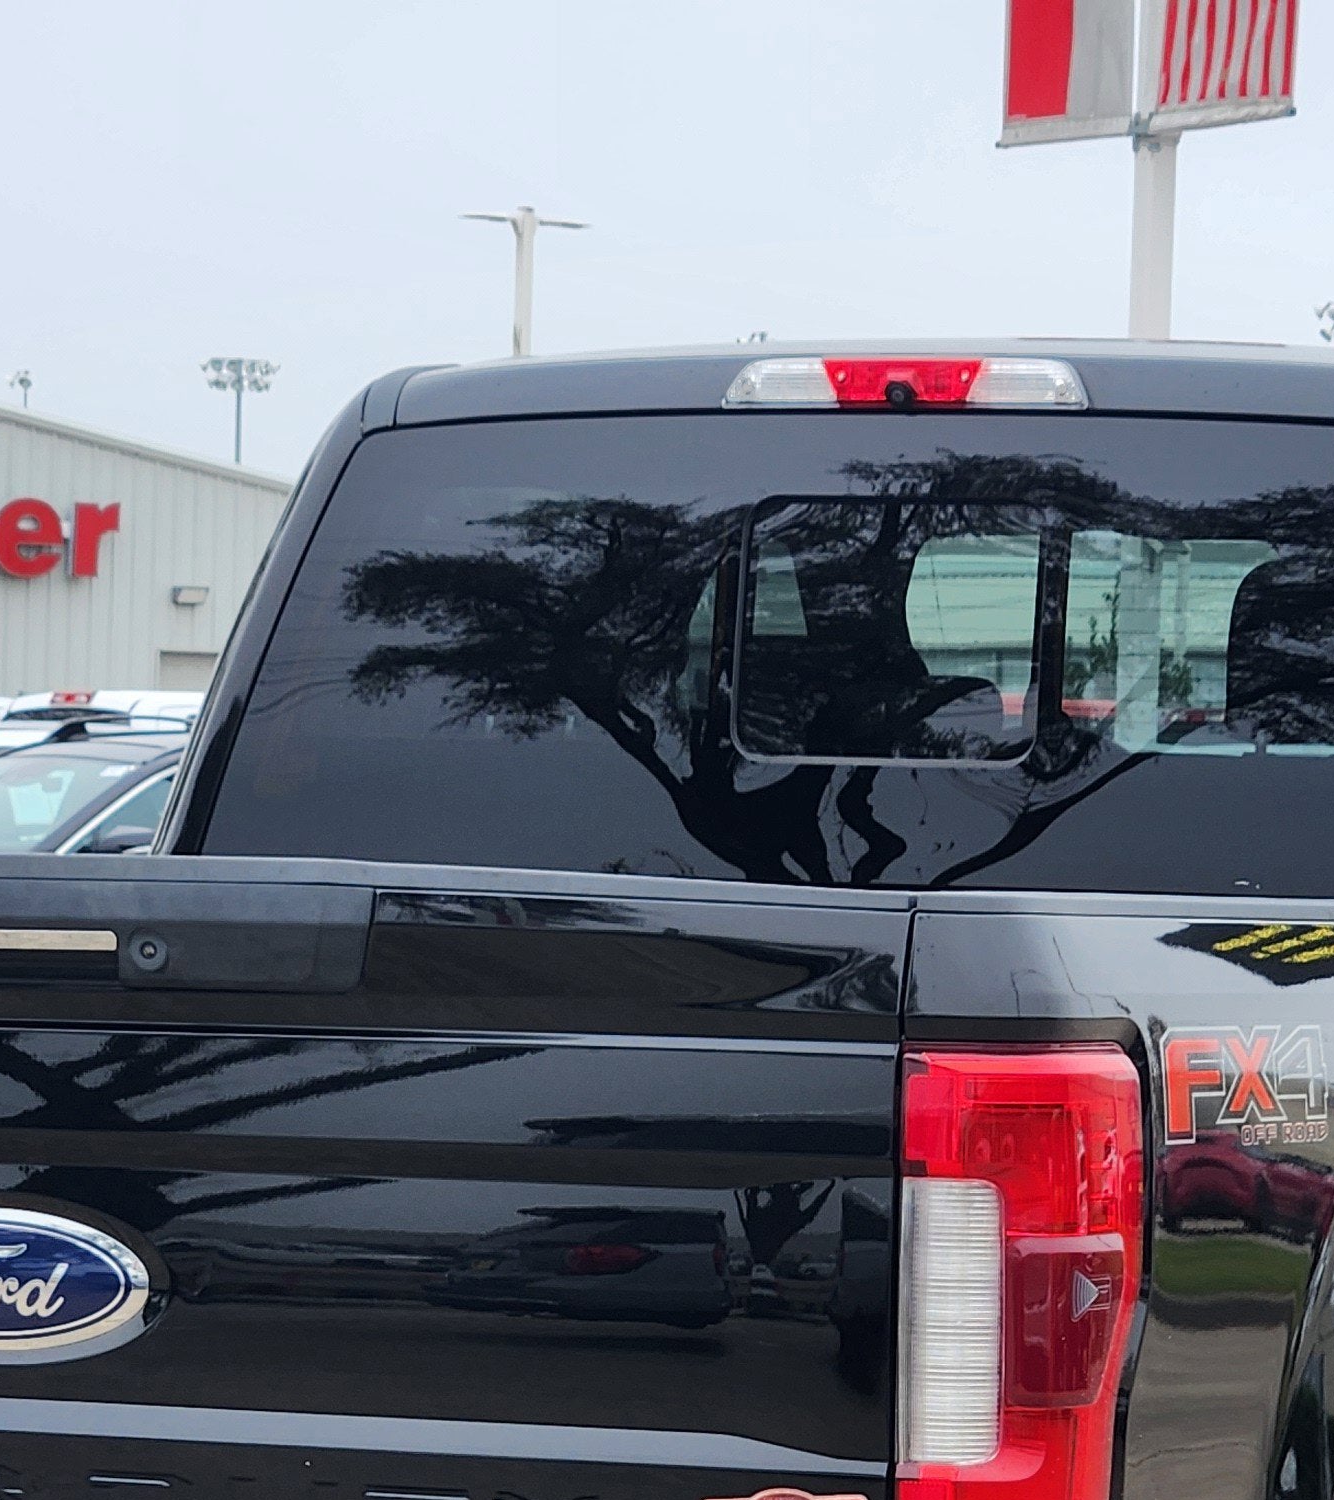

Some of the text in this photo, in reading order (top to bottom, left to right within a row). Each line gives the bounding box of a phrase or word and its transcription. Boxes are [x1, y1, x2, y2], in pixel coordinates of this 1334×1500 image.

[1160, 1025, 1329, 1145] FX4
[1241, 1121, 1329, 1146] OFF ROAD
